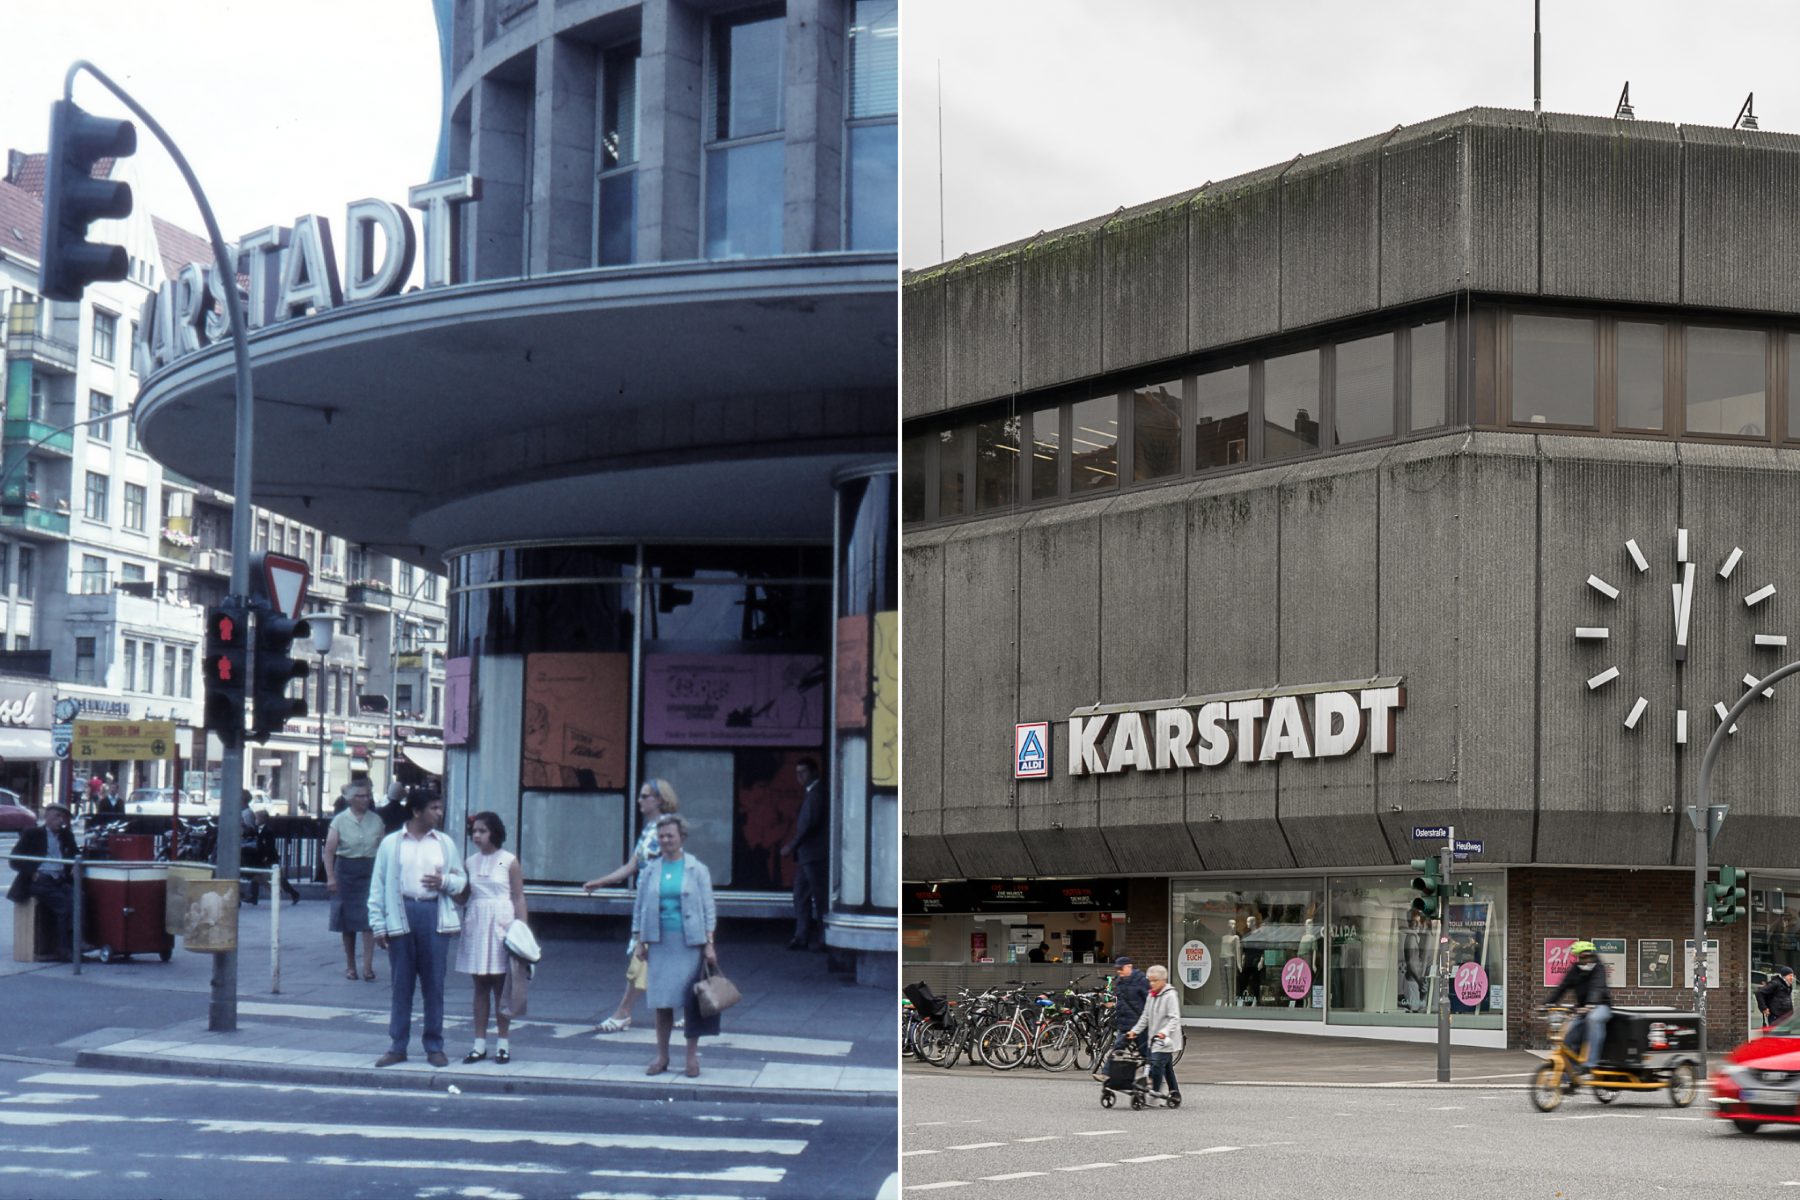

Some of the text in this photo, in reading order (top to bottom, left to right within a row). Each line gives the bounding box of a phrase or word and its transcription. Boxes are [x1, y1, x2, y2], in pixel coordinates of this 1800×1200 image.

[1068, 684, 1406, 776] KARSTADT
[1020, 760, 1042, 771] ALDI
[1415, 828, 1447, 838] Osterstraße
[1455, 841, 1482, 853] Heußweg
[1186, 954, 1203, 962] EUCH
[1547, 945, 1571, 964] 21
[1285, 961, 1305, 982] 21
[1458, 966, 1479, 988] 21
